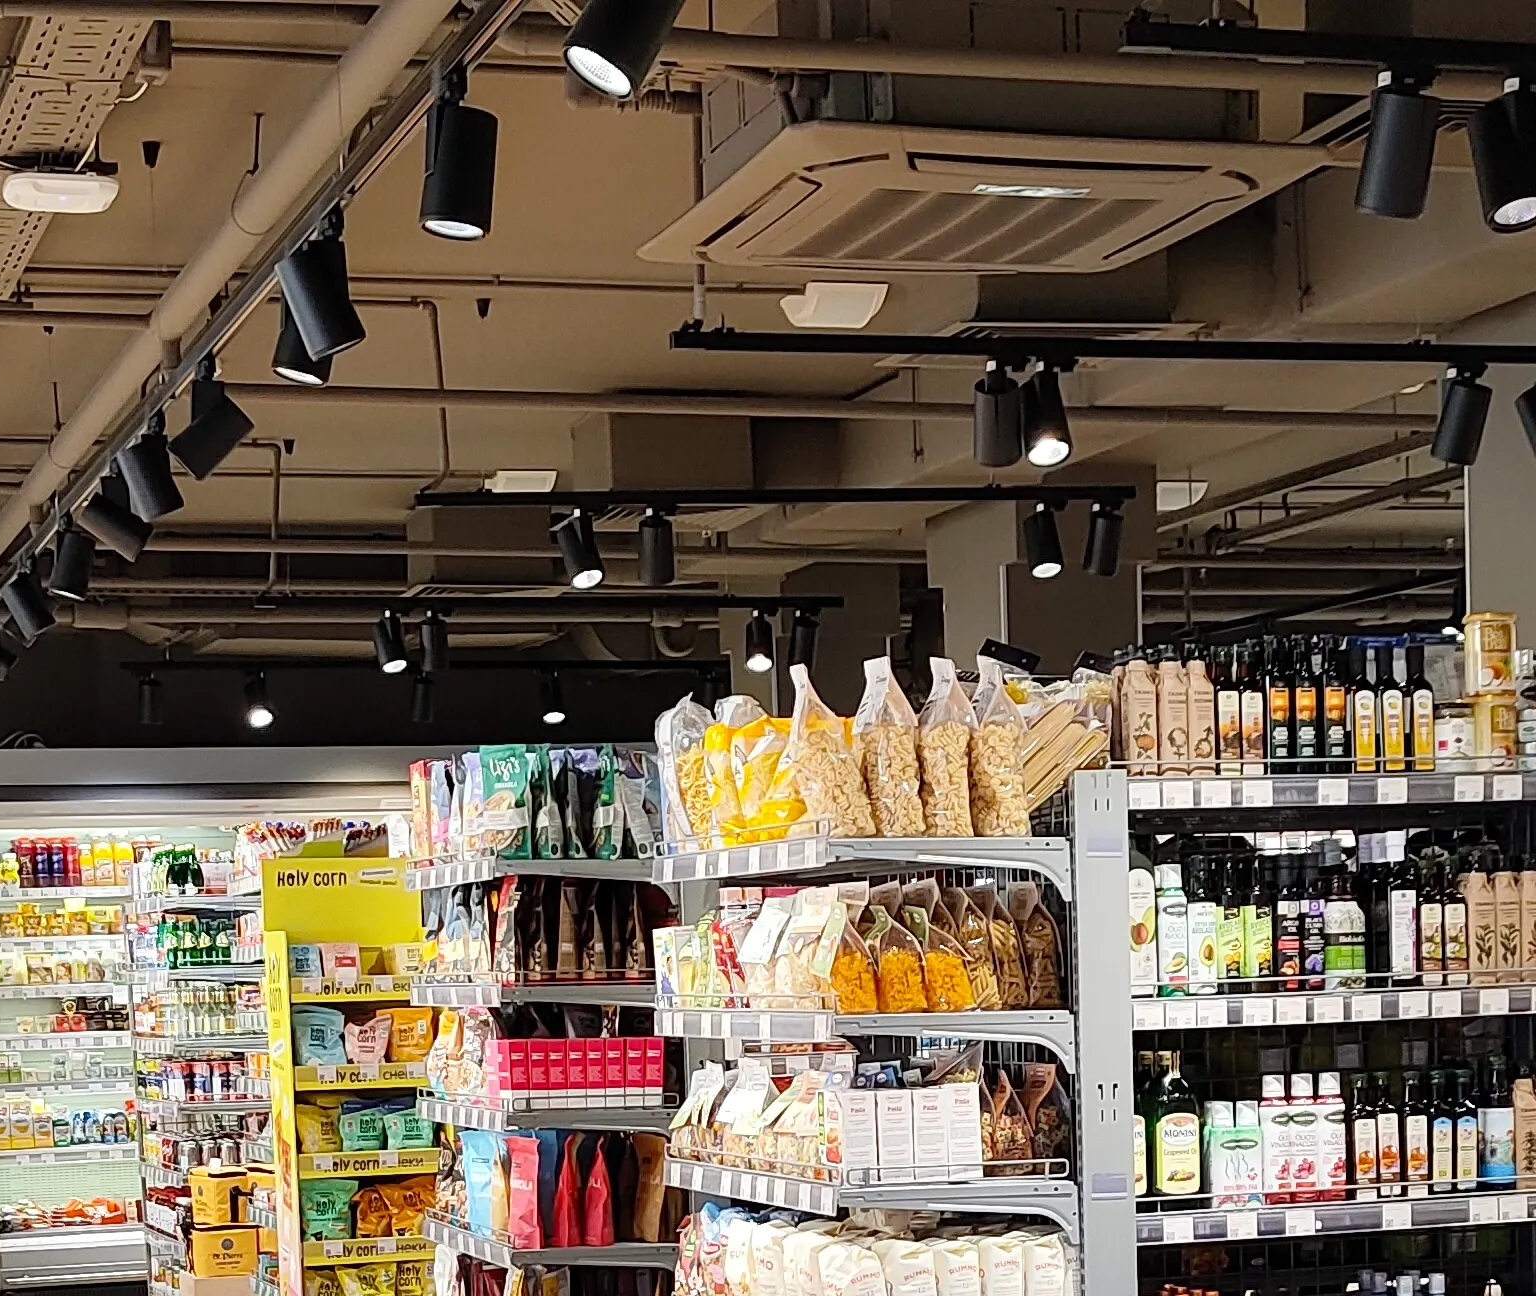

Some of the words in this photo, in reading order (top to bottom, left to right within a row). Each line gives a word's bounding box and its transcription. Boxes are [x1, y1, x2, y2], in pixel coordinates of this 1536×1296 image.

[277, 869, 309, 887] Holy
[314, 872, 347, 887] corn
[315, 982, 340, 996] oly
[324, 1158, 350, 1173] oly
[353, 1159, 379, 1171] corn
[356, 1245, 379, 1256] cor
[397, 1243, 427, 1252] неки
[948, 1264, 977, 1276] RUMMO
[994, 1259, 1019, 1269] RUMMO
[399, 1265, 421, 1277] Holy
[399, 1276, 421, 1287] corn
[850, 1271, 881, 1285] RUMMO
